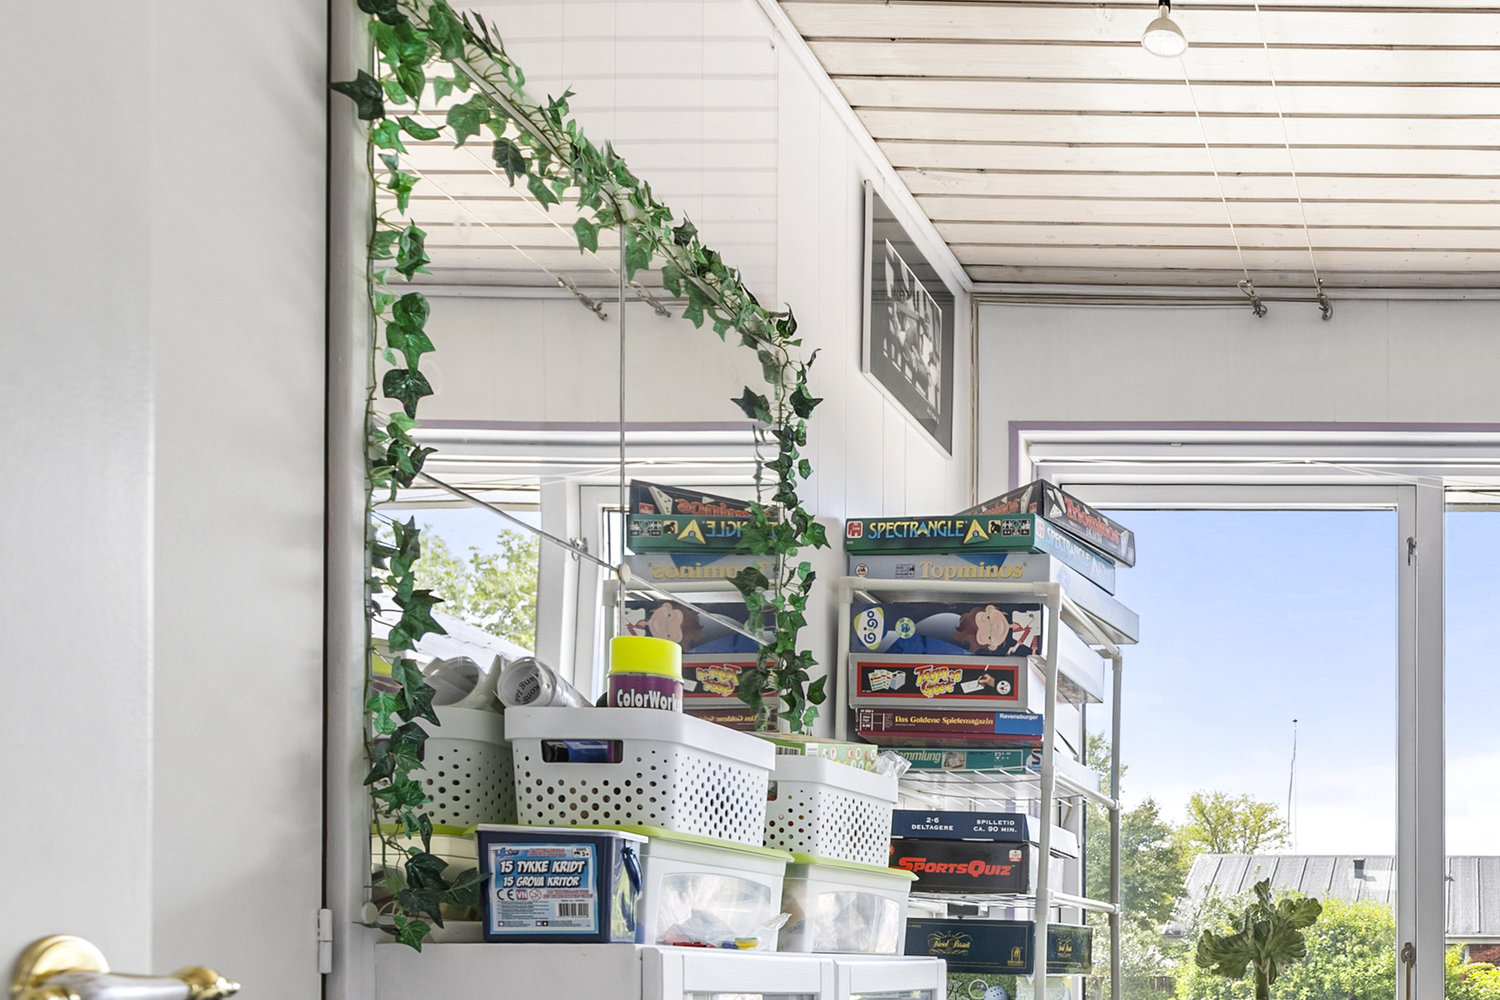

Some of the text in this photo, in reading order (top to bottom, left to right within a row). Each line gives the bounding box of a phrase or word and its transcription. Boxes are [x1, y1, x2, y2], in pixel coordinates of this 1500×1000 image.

[868, 519, 966, 540] SPECTRANGLE
[919, 561, 1024, 581] Topminos
[863, 610, 879, 644] Gigo
[895, 715, 909, 724] Das
[910, 715, 941, 725] Goldene
[942, 716, 994, 727] Spielemagazin
[999, 713, 1039, 721] Ravensburger
[500, 860, 586, 873] 15 TYKKE KRIDT
[503, 876, 580, 887] 15 GROVA KRITOR
